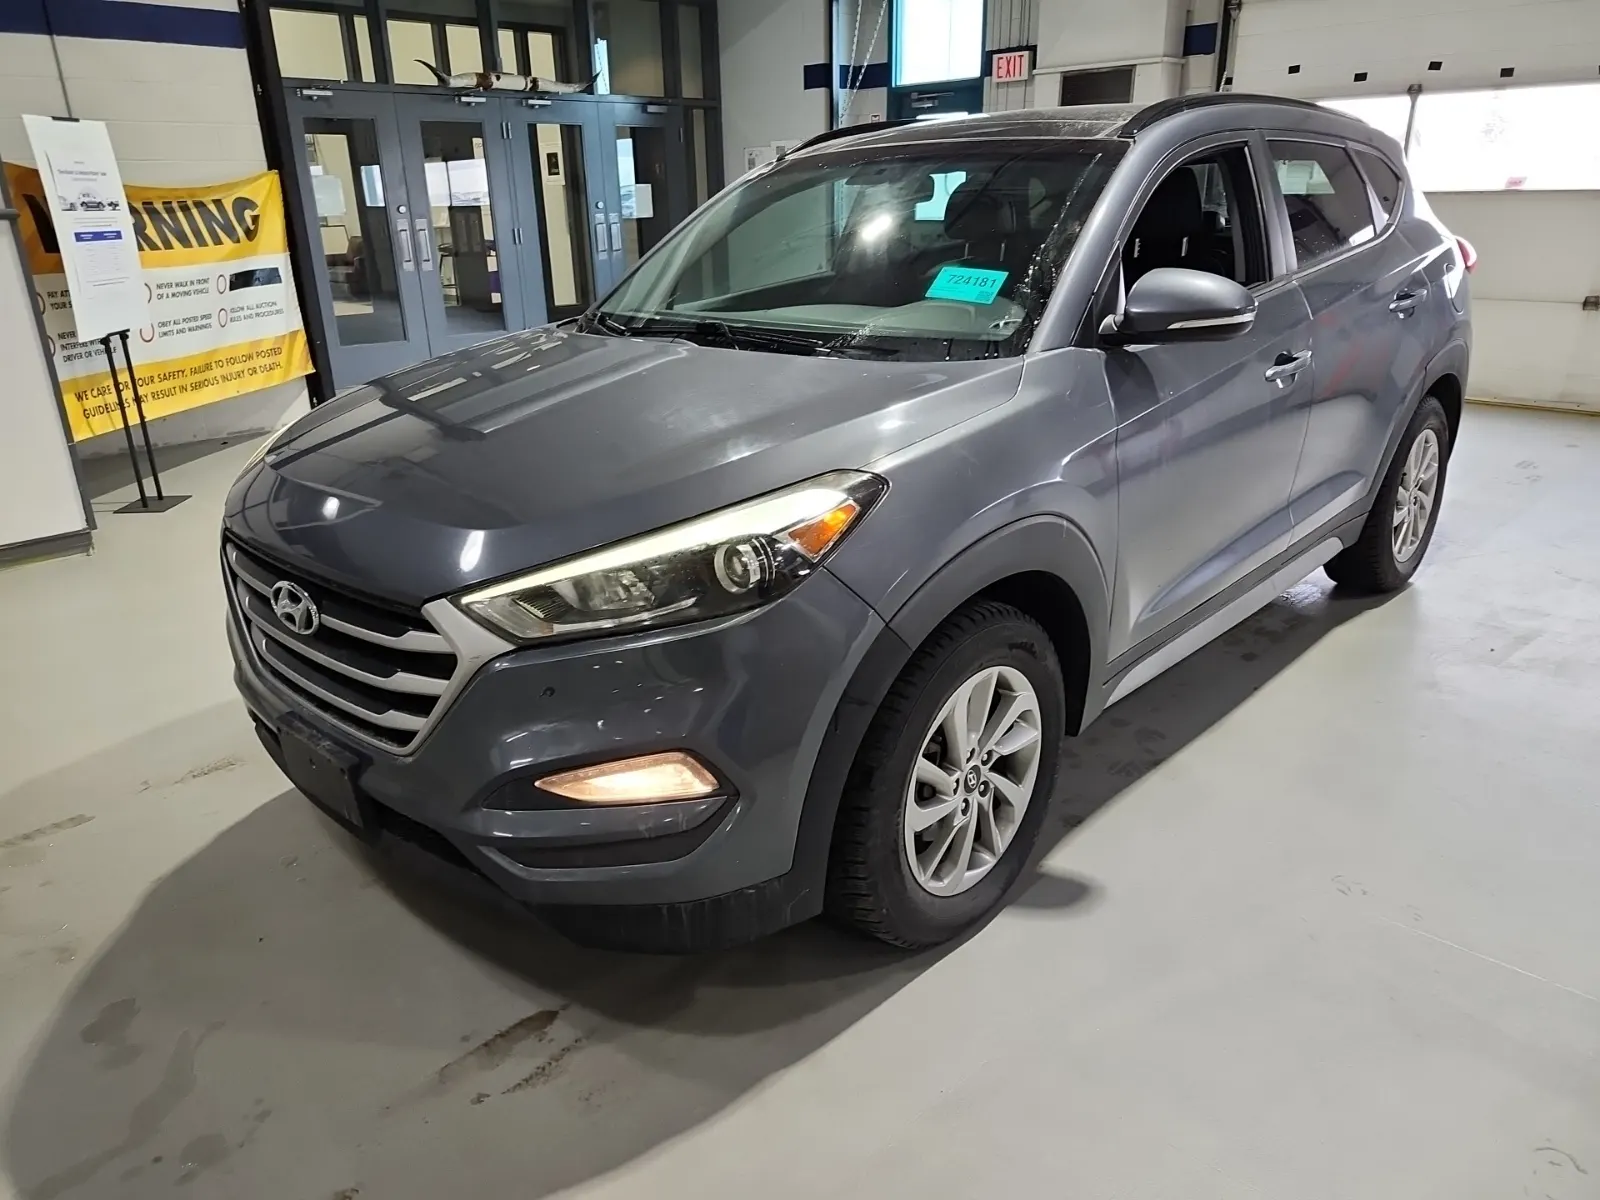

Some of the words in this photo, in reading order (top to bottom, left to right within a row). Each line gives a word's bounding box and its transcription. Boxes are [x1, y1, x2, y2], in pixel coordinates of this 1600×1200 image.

[997, 54, 1024, 78] EXIT
[174, 280, 188, 288] WALK
[946, 274, 997, 288] 724181
[46, 290, 58, 298] PAY
[50, 302, 68, 310] YOUR
[158, 320, 172, 328] OBEY
[182, 316, 199, 324] POSTED
[58, 331, 76, 340] NEVER
[158, 329, 174, 338] LIMITS
[187, 323, 212, 332] WARNINGS
[63, 353, 83, 362] DRIVER
[74, 390, 89, 403] WE
[91, 384, 112, 398] CARE
[116, 381, 130, 392] OR
[134, 375, 155, 387] OUR
[158, 369, 188, 383] SAFETY.
[190, 362, 213, 376] FAILURE
[214, 360, 224, 369] TO
[226, 352, 254, 366] FOLLOW
[256, 346, 282, 359] POSTED
[151, 387, 177, 401] RESULT
[179, 384, 188, 393] IN
[190, 376, 219, 391] SERIOUS
[220, 369, 245, 383] INJURY
[248, 366, 258, 377] OR
[260, 361, 283, 373] DEATH.
